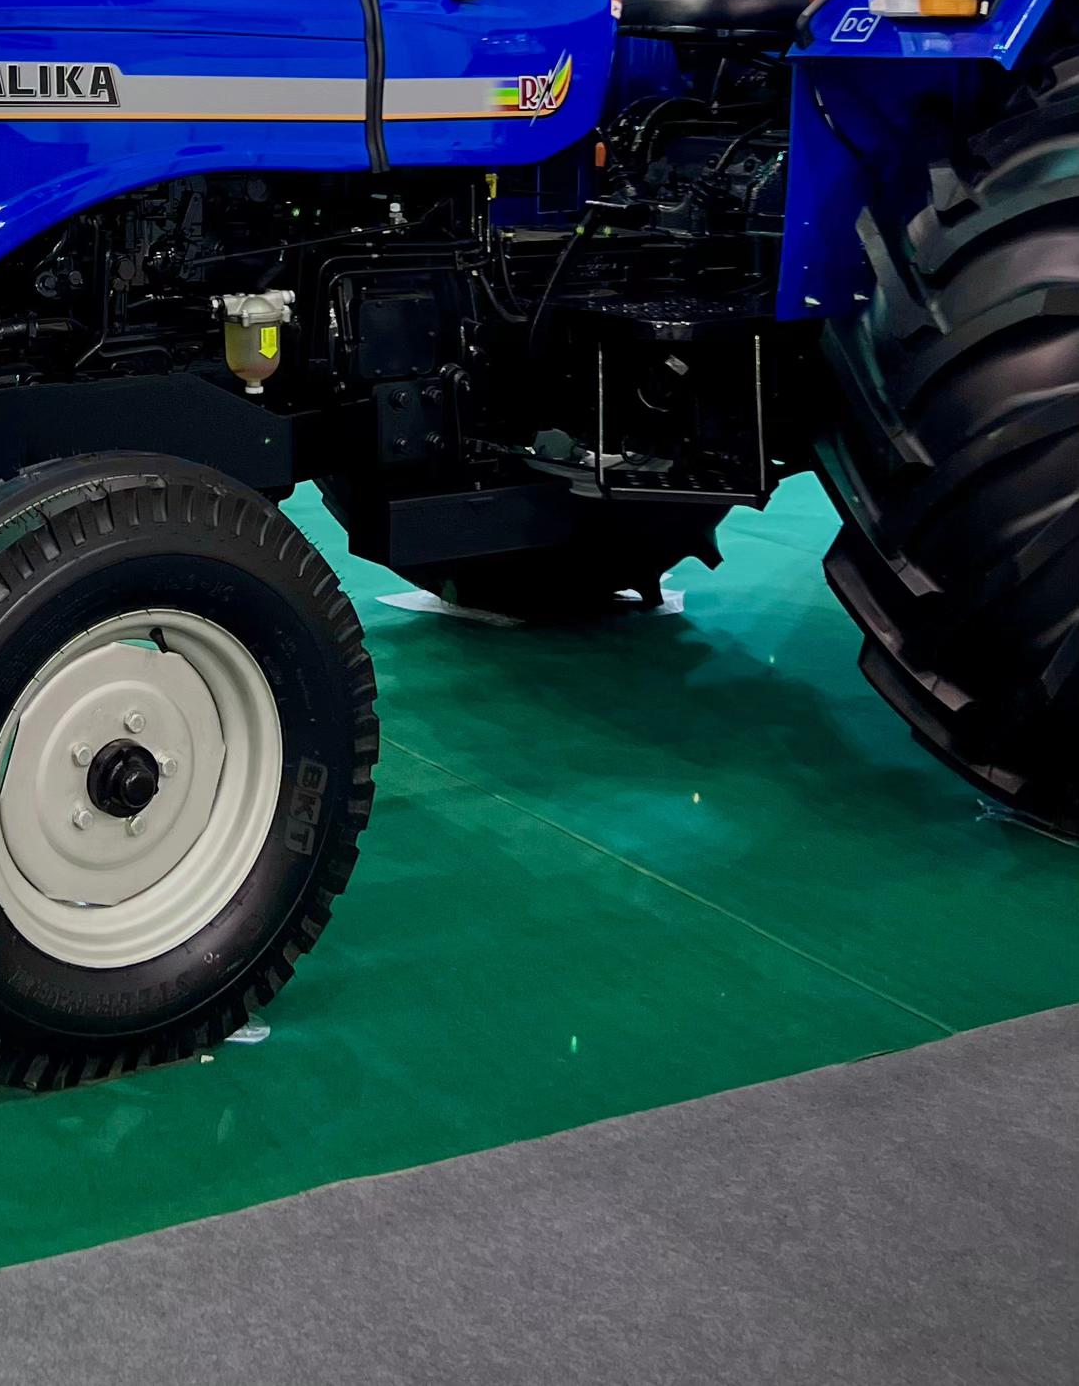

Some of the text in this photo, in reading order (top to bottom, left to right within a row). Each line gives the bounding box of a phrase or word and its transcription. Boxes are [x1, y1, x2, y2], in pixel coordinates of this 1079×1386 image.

[840, 17, 874, 32] DC
[519, 67, 559, 112] RX
[285, 757, 329, 856] BKT
